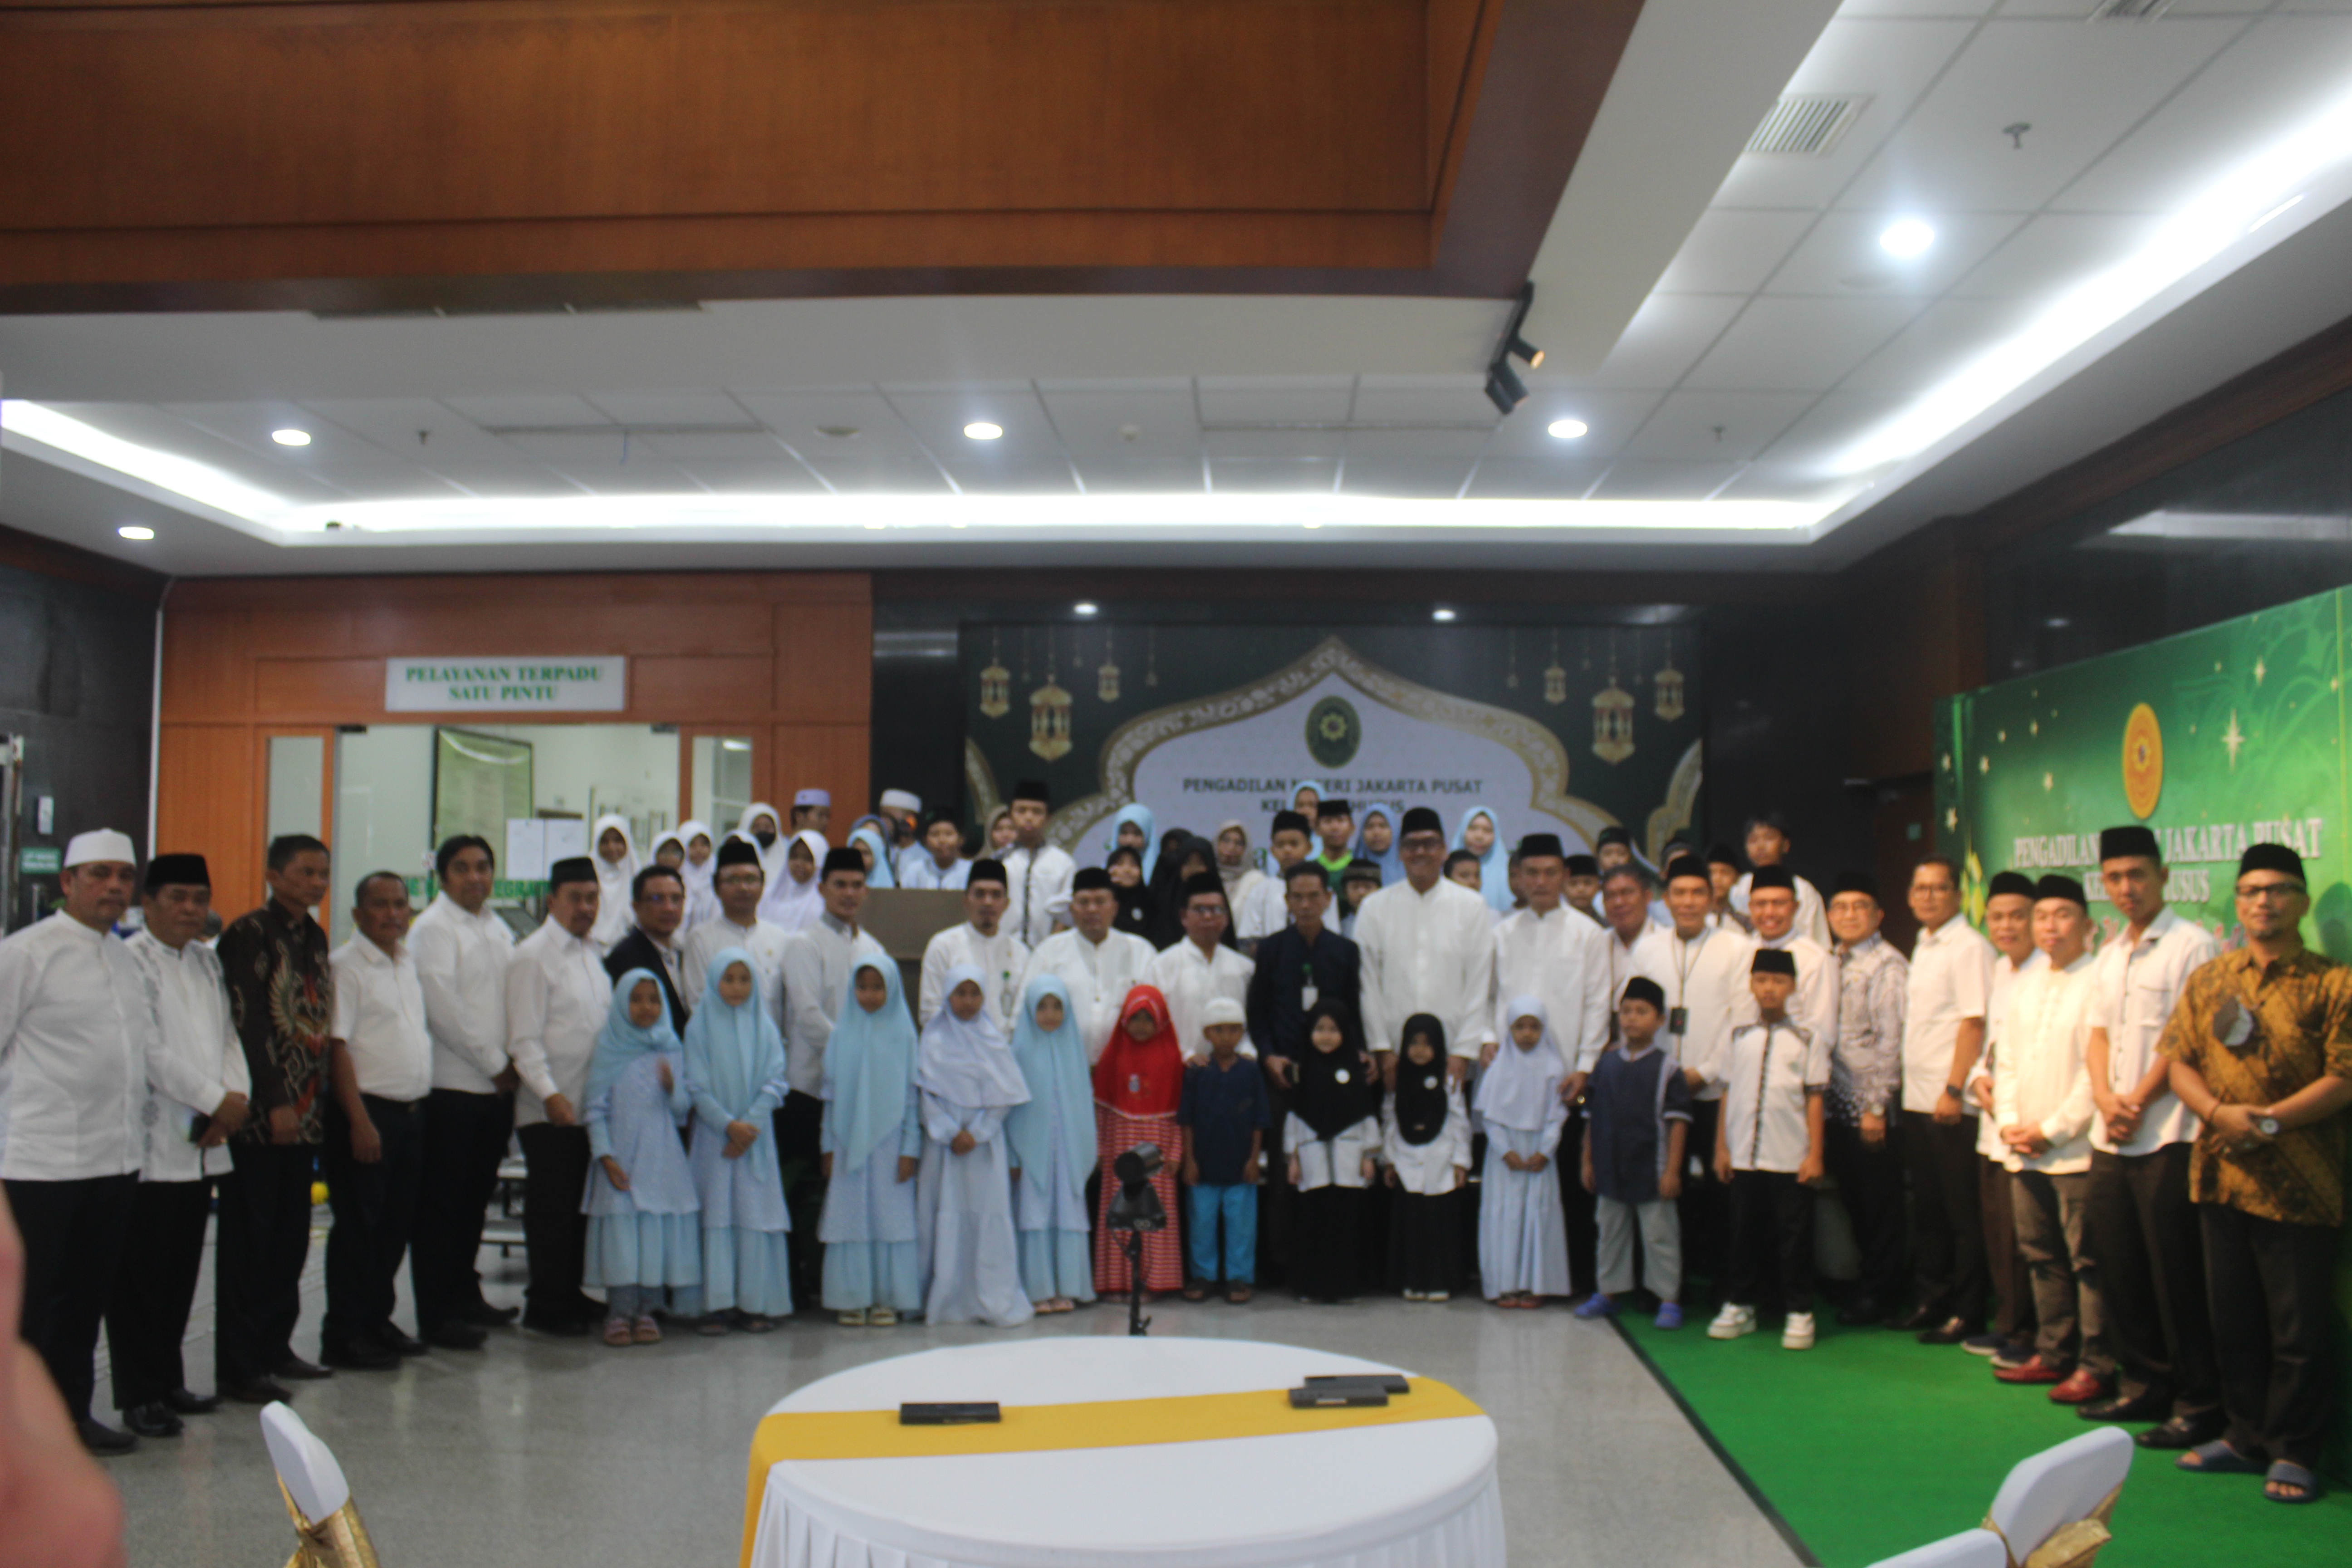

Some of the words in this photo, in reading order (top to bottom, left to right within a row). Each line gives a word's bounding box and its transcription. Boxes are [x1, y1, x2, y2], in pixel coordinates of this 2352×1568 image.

[406, 666, 511, 681] PELAYANAN
[518, 665, 602, 681] TERPADU
[449, 686, 494, 700] SATU
[501, 686, 557, 700] PINTU
[1183, 778, 1286, 792] PENGADILAN
[1357, 779, 1427, 793] JAKARTA
[1432, 779, 1482, 794] PUSAT
[2164, 823, 2248, 863] JAKARTA
[2253, 818, 2322, 858] PUSAT
[2163, 869, 2210, 902] USUS
